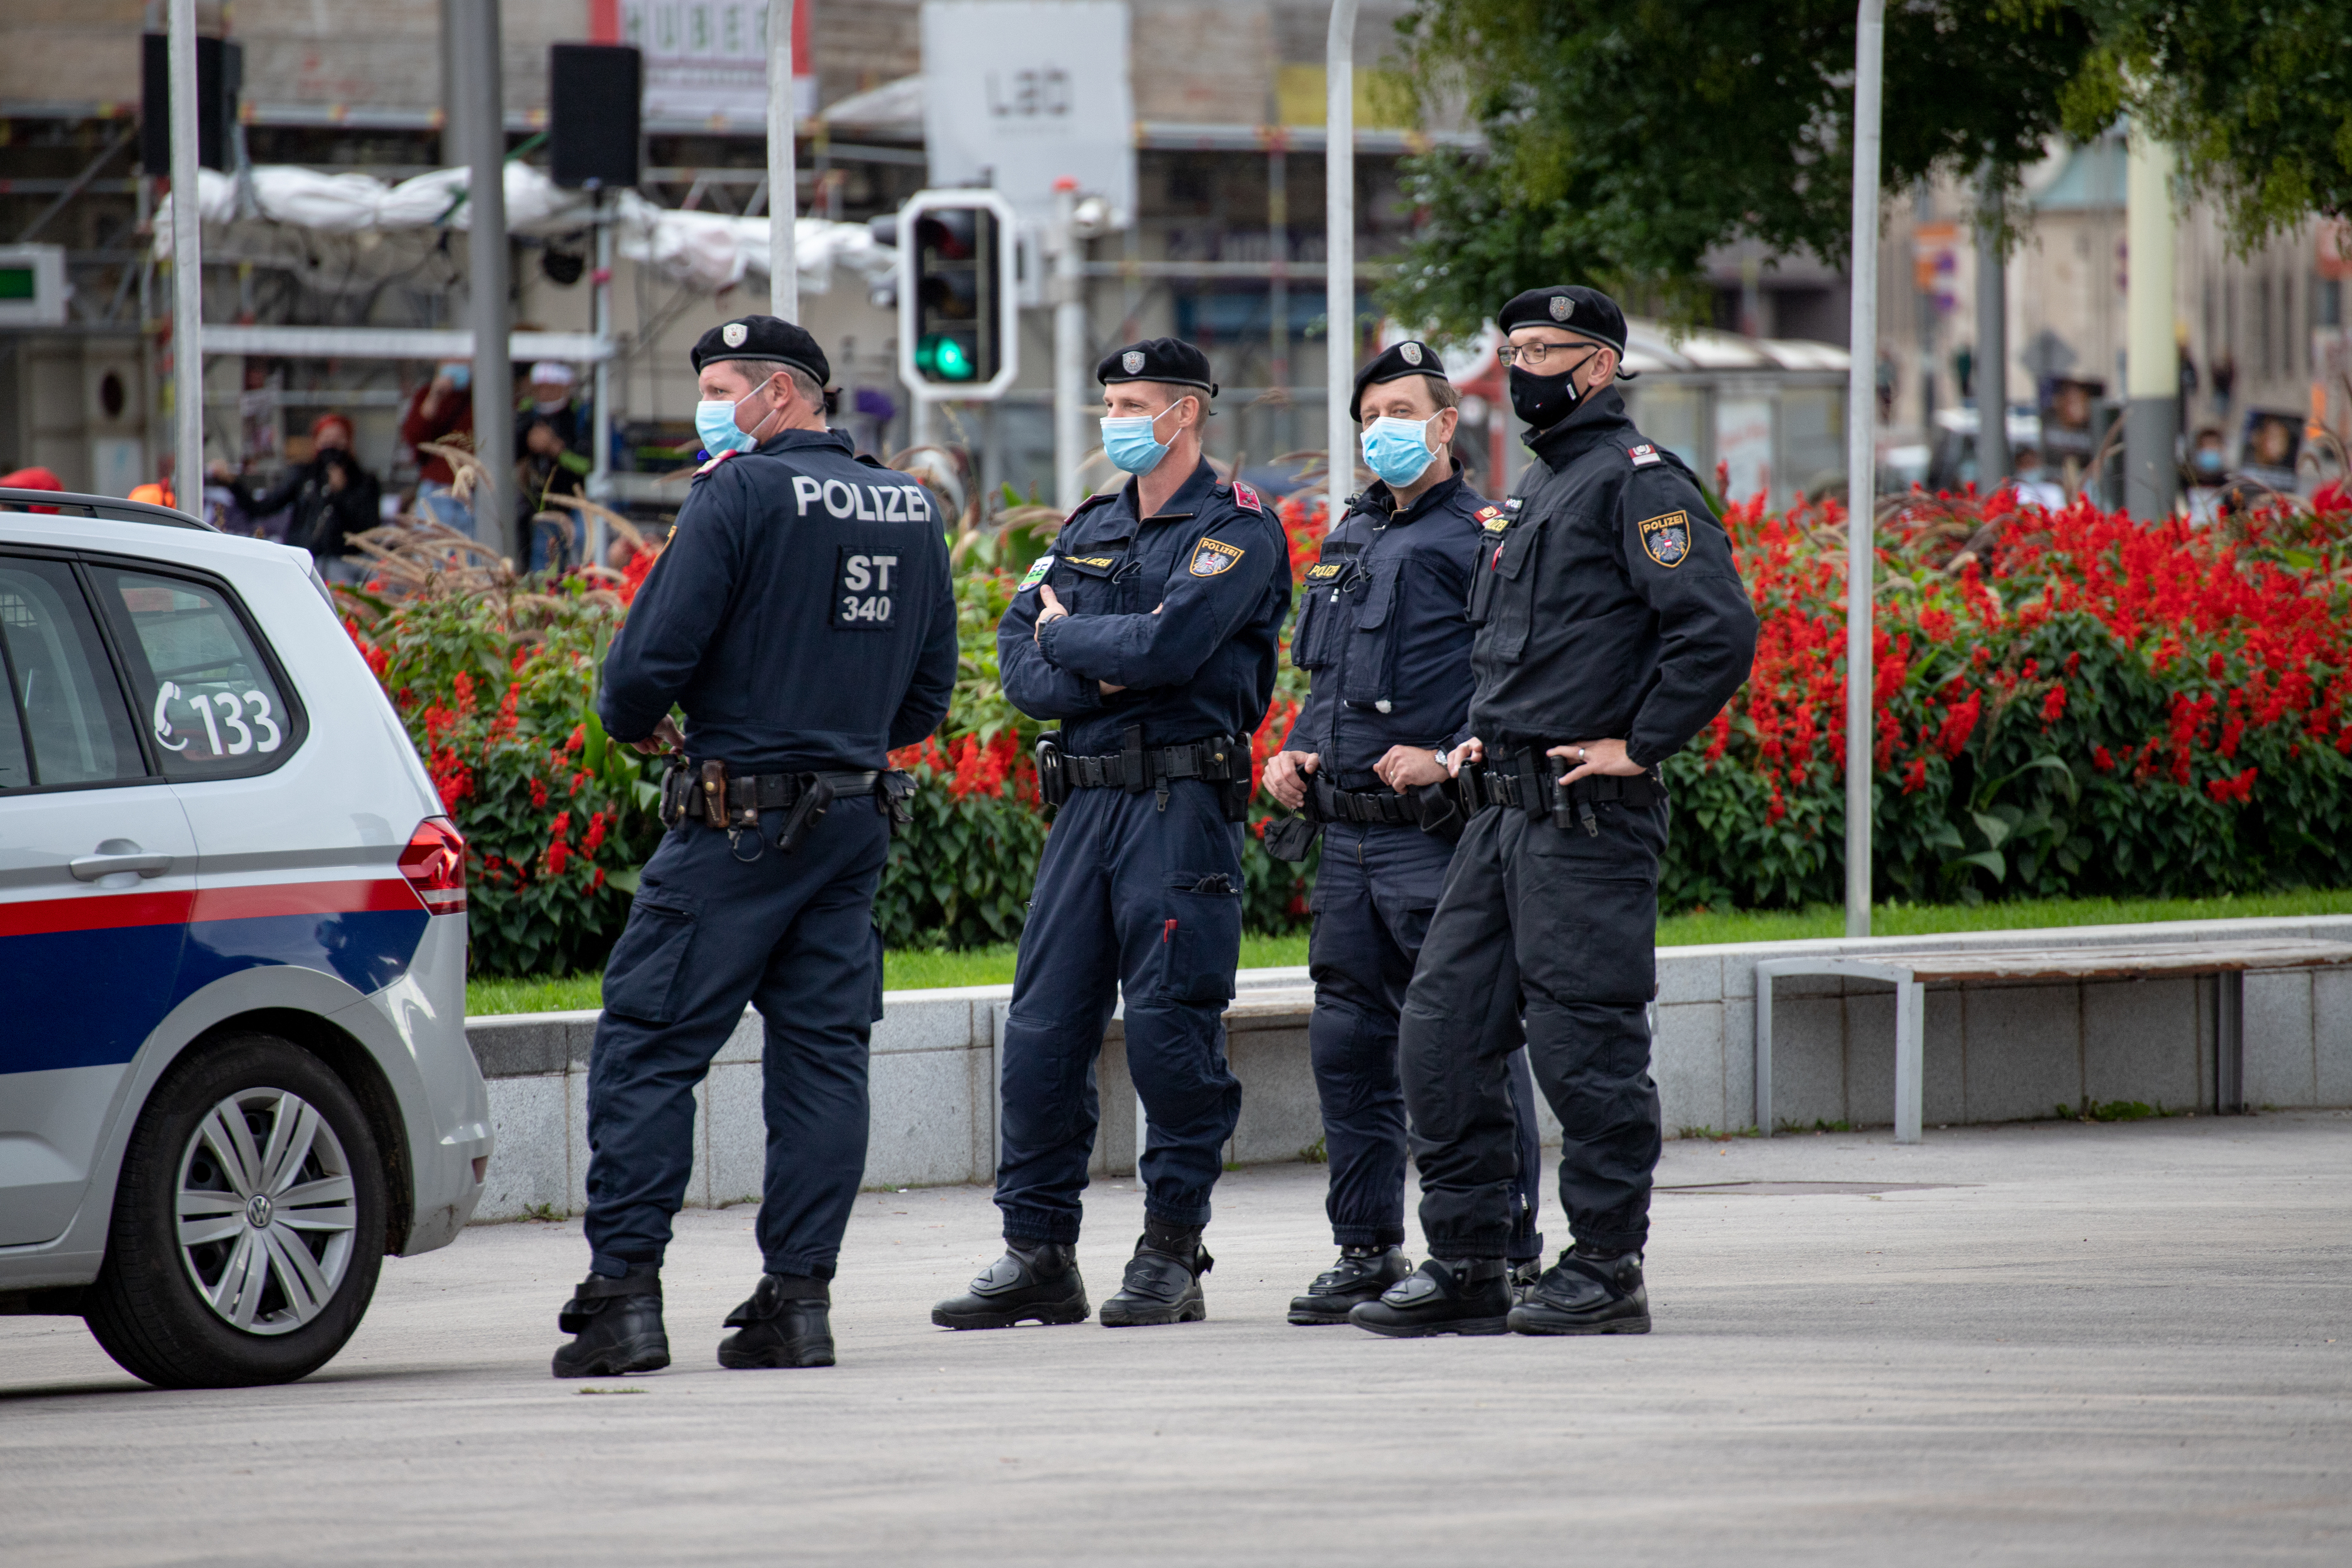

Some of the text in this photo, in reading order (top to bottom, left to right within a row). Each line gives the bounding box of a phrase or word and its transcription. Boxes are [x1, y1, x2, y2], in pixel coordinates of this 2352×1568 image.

[791, 476, 931, 522] POLIZEI
[1643, 514, 1684, 534] POLIZEI
[1202, 540, 1238, 557] POLIZEI
[844, 554, 897, 591] ST
[841, 596, 891, 621] 340
[188, 690, 281, 755] 133
